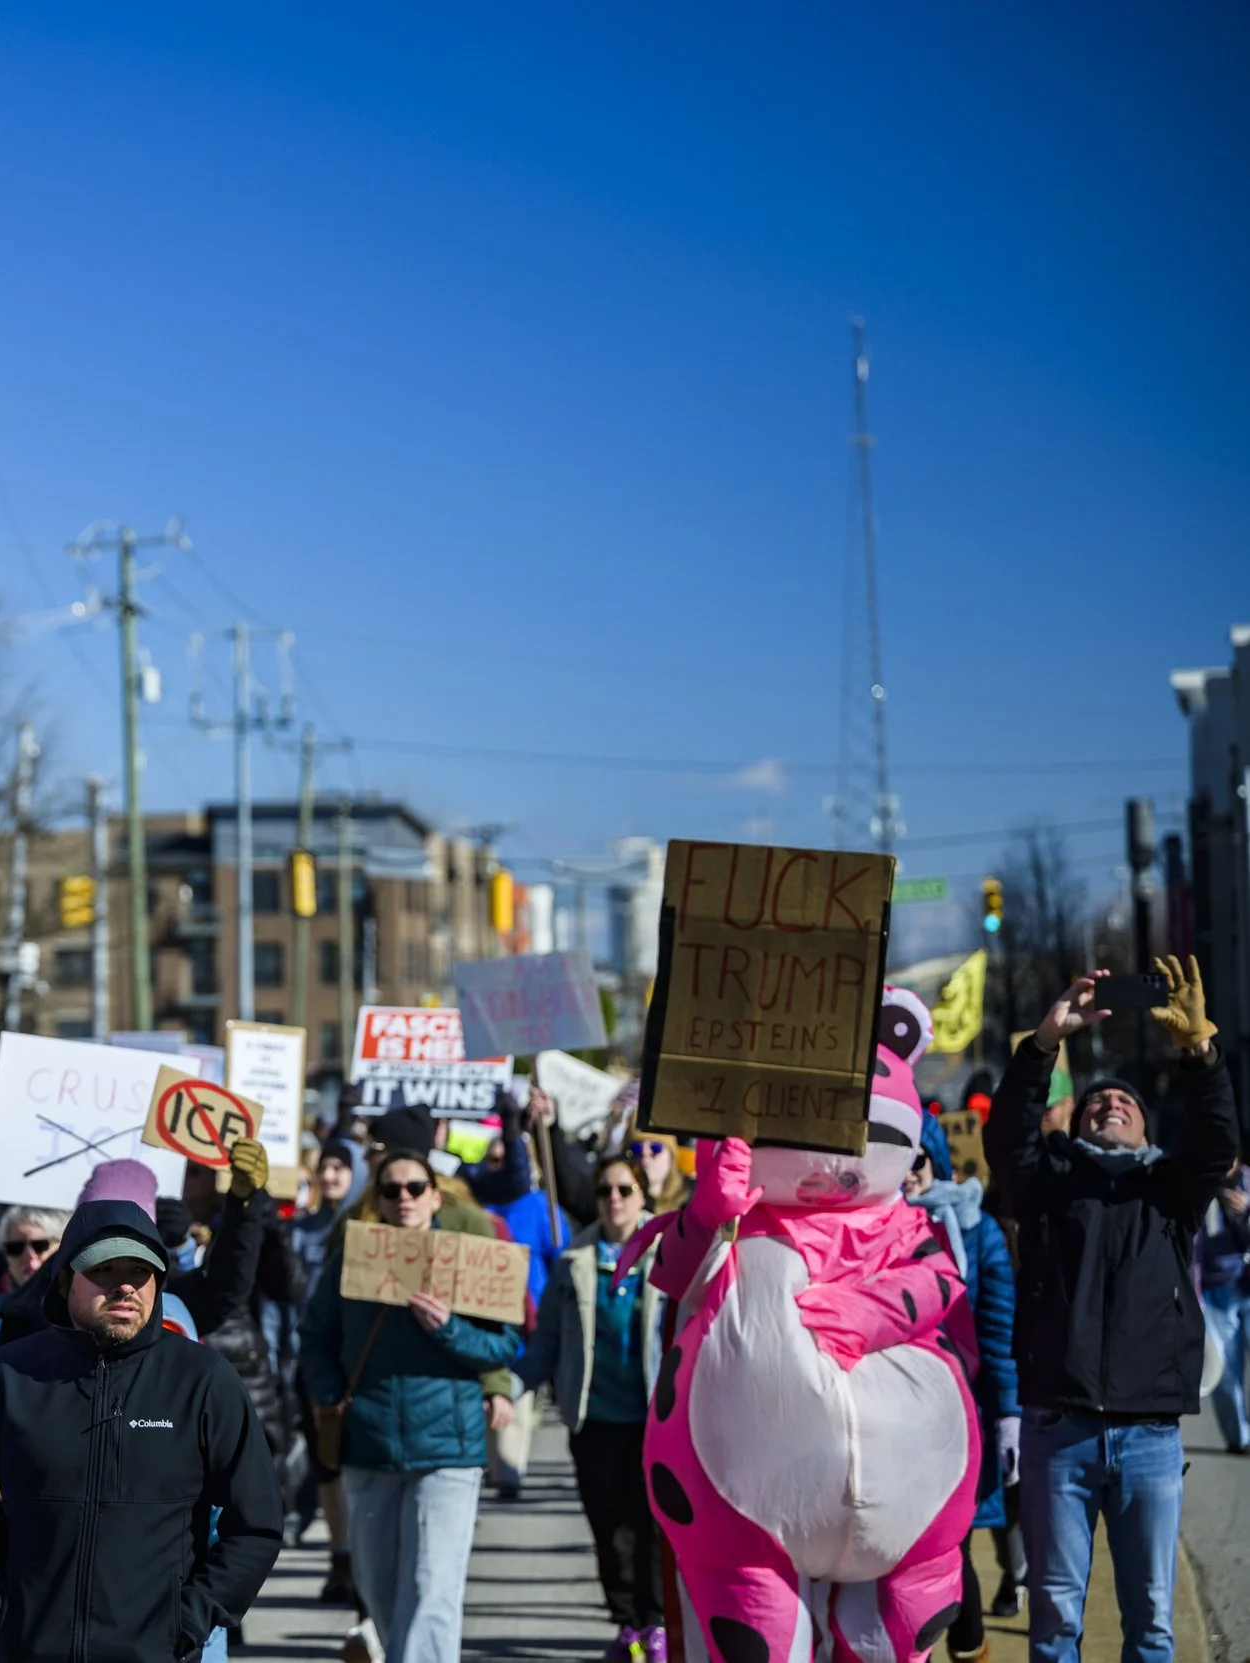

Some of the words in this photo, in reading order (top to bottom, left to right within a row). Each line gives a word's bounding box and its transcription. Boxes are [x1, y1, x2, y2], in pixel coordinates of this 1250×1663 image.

[678, 844, 872, 933] FUCK
[679, 942, 865, 1014] TRUMP
[370, 1015, 462, 1037] FASCI
[689, 1016, 838, 1051] EPSTEIN'S
[377, 1036, 405, 1058] IS
[26, 1067, 148, 1114] CRUS
[362, 1079, 398, 1106] IT
[402, 1081, 497, 1110] WINS
[742, 1080, 849, 1121] CLIENT
[363, 1228, 456, 1264] JESUS
[464, 1242, 511, 1274] WAS
[376, 1270, 398, 1298] A
[419, 1264, 518, 1308] REFUGEE
[138, 1419, 174, 1428] Columbia
